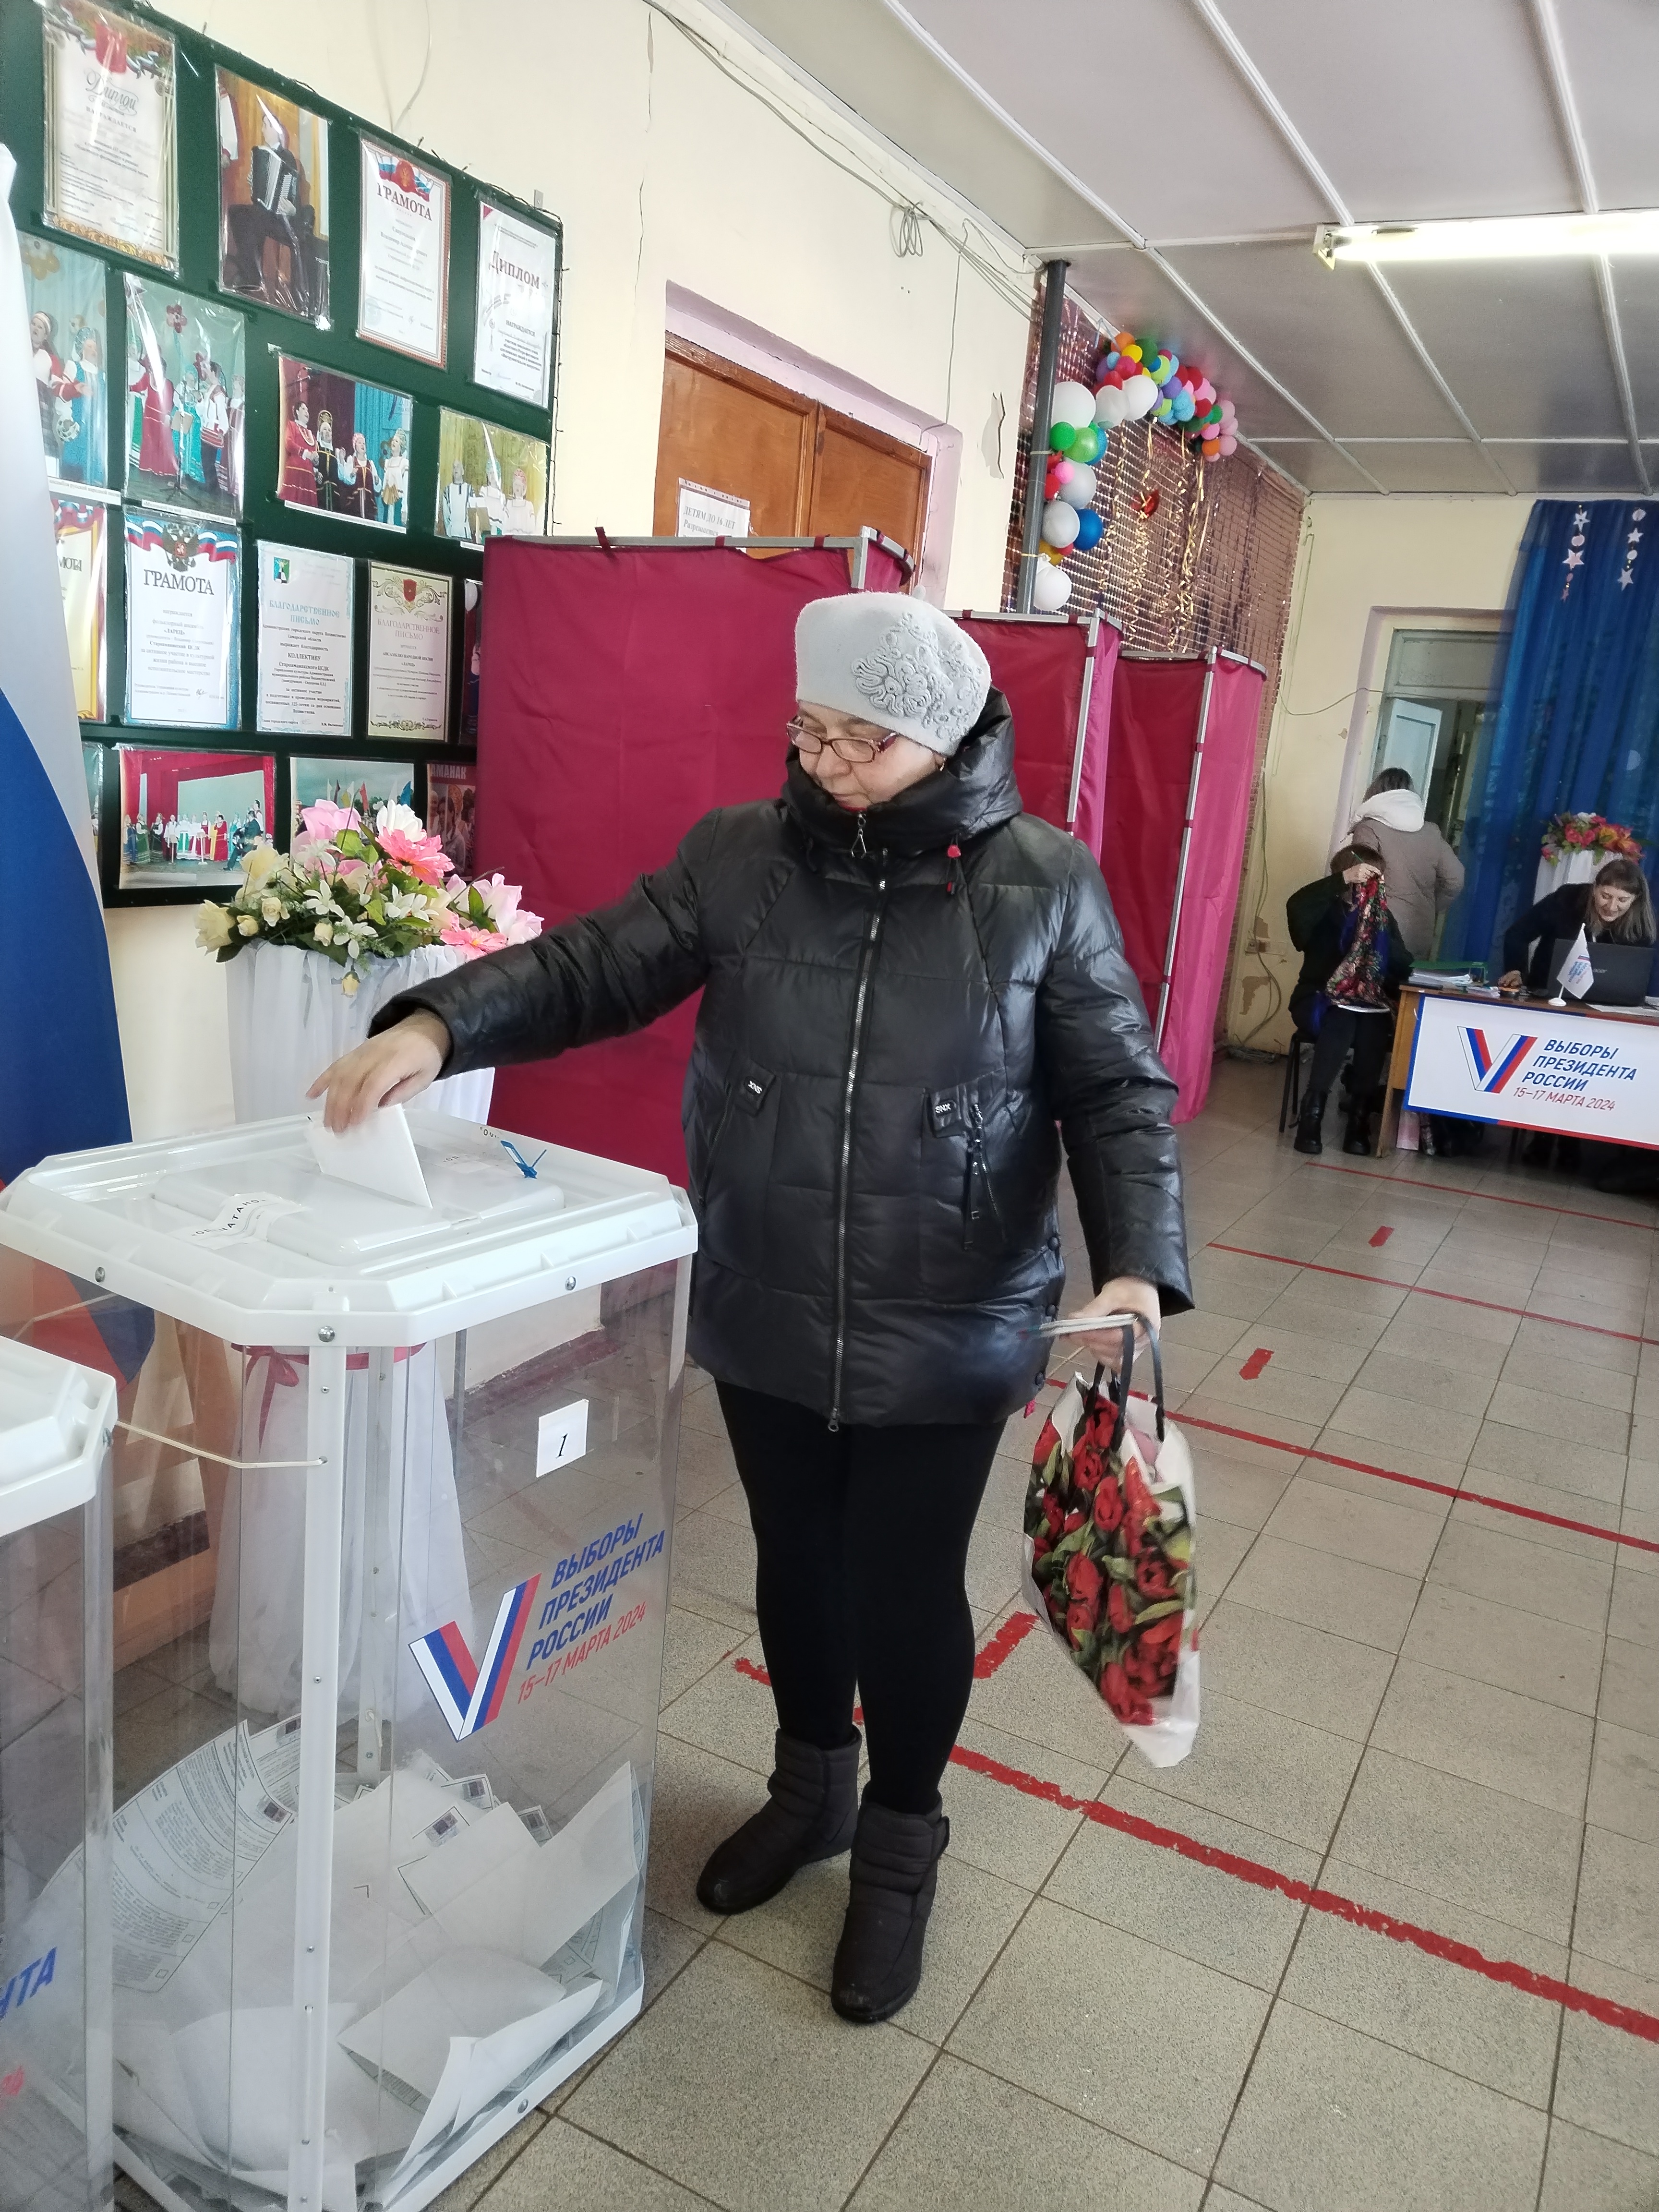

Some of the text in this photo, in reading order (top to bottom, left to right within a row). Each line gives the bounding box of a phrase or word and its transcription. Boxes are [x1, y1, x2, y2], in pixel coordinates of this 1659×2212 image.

[86, 107, 136, 132] НАРАЖДАЕТСЯ
[683, 506, 735, 529] ДЕТЯМ ДО 16 ЛЕТ
[144, 569, 214, 595] ГРАМОТА
[270, 600, 340, 618] БЛАГОДАРСТВЕННОЕ
[290, 614, 320, 625] ПИСЬМО
[378, 618, 440, 634] БЛАГОДАРСТВЕННОЕ
[395, 630, 423, 640] ПИСЬМО
[288, 652, 321, 661] КОЛЛЕКТИВУ
[1544, 1039, 1619, 1059] ВЫБОРЫ
[1533, 1056, 1637, 1080] ПРЕЗИДЕНТА
[1522, 1072, 1588, 1091] РОССИИ
[1545, 1092, 1585, 1106] МАРТА
[1586, 1098, 1615, 1111] 2024
[551, 1513, 644, 1589] ВЫБОРЫ
[539, 1529, 665, 1630] ПРЕЗИДЕНТА
[526, 1593, 613, 1671] РОССИИ
[563, 1624, 612, 1675] МАРТА
[613, 1601, 646, 1640] 2024
